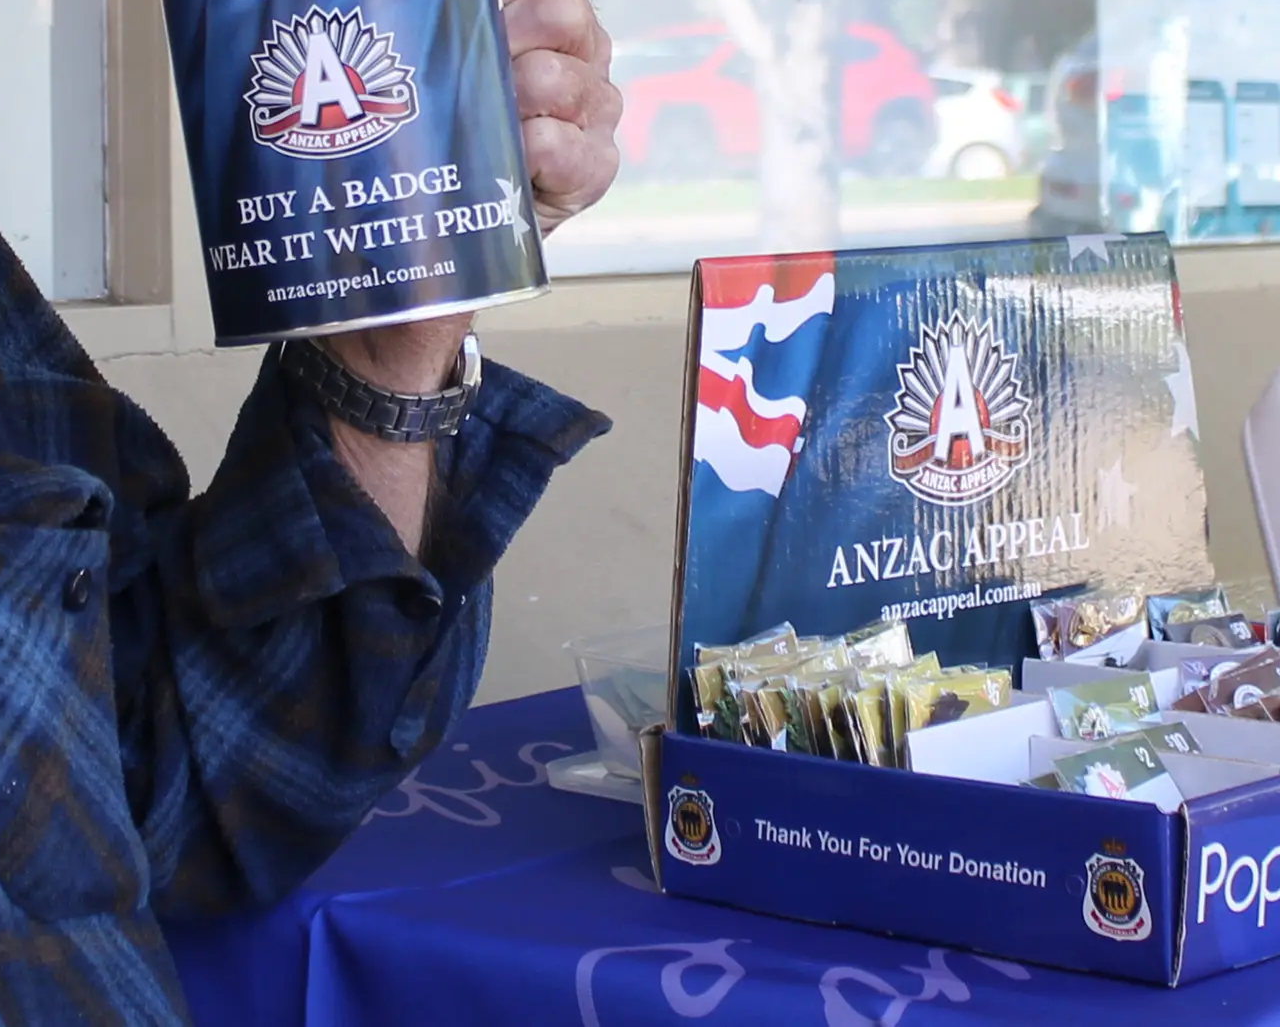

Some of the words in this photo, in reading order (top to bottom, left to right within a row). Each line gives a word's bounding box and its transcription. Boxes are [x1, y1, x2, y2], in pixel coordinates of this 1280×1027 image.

[300, 33, 366, 126] A
[288, 132, 332, 148] ANZAC
[334, 119, 383, 146] APPEAL
[236, 190, 297, 225] BUY
[308, 186, 336, 214] A
[341, 163, 463, 209] BADGE
[208, 238, 277, 272] WEAR
[281, 231, 315, 262] IT
[323, 214, 428, 256] WITH
[434, 198, 518, 238] PRIDE
[266, 257, 457, 304] anzacappeal.com.au
[933, 343, 986, 466] A
[922, 470, 957, 493] ANZAC
[959, 464, 1002, 490] APPEAL
[826, 530, 954, 588] ANZAC
[961, 511, 1091, 568] APPEAL
[880, 579, 1043, 622] anzacappeal.com.au
[1134, 746, 1156, 769] $2
[1163, 731, 1190, 754] $10
[754, 818, 813, 849] Thank
[816, 829, 853, 856] You
[858, 837, 892, 862] For
[895, 842, 943, 871] Your
[948, 851, 1047, 888] Donation
